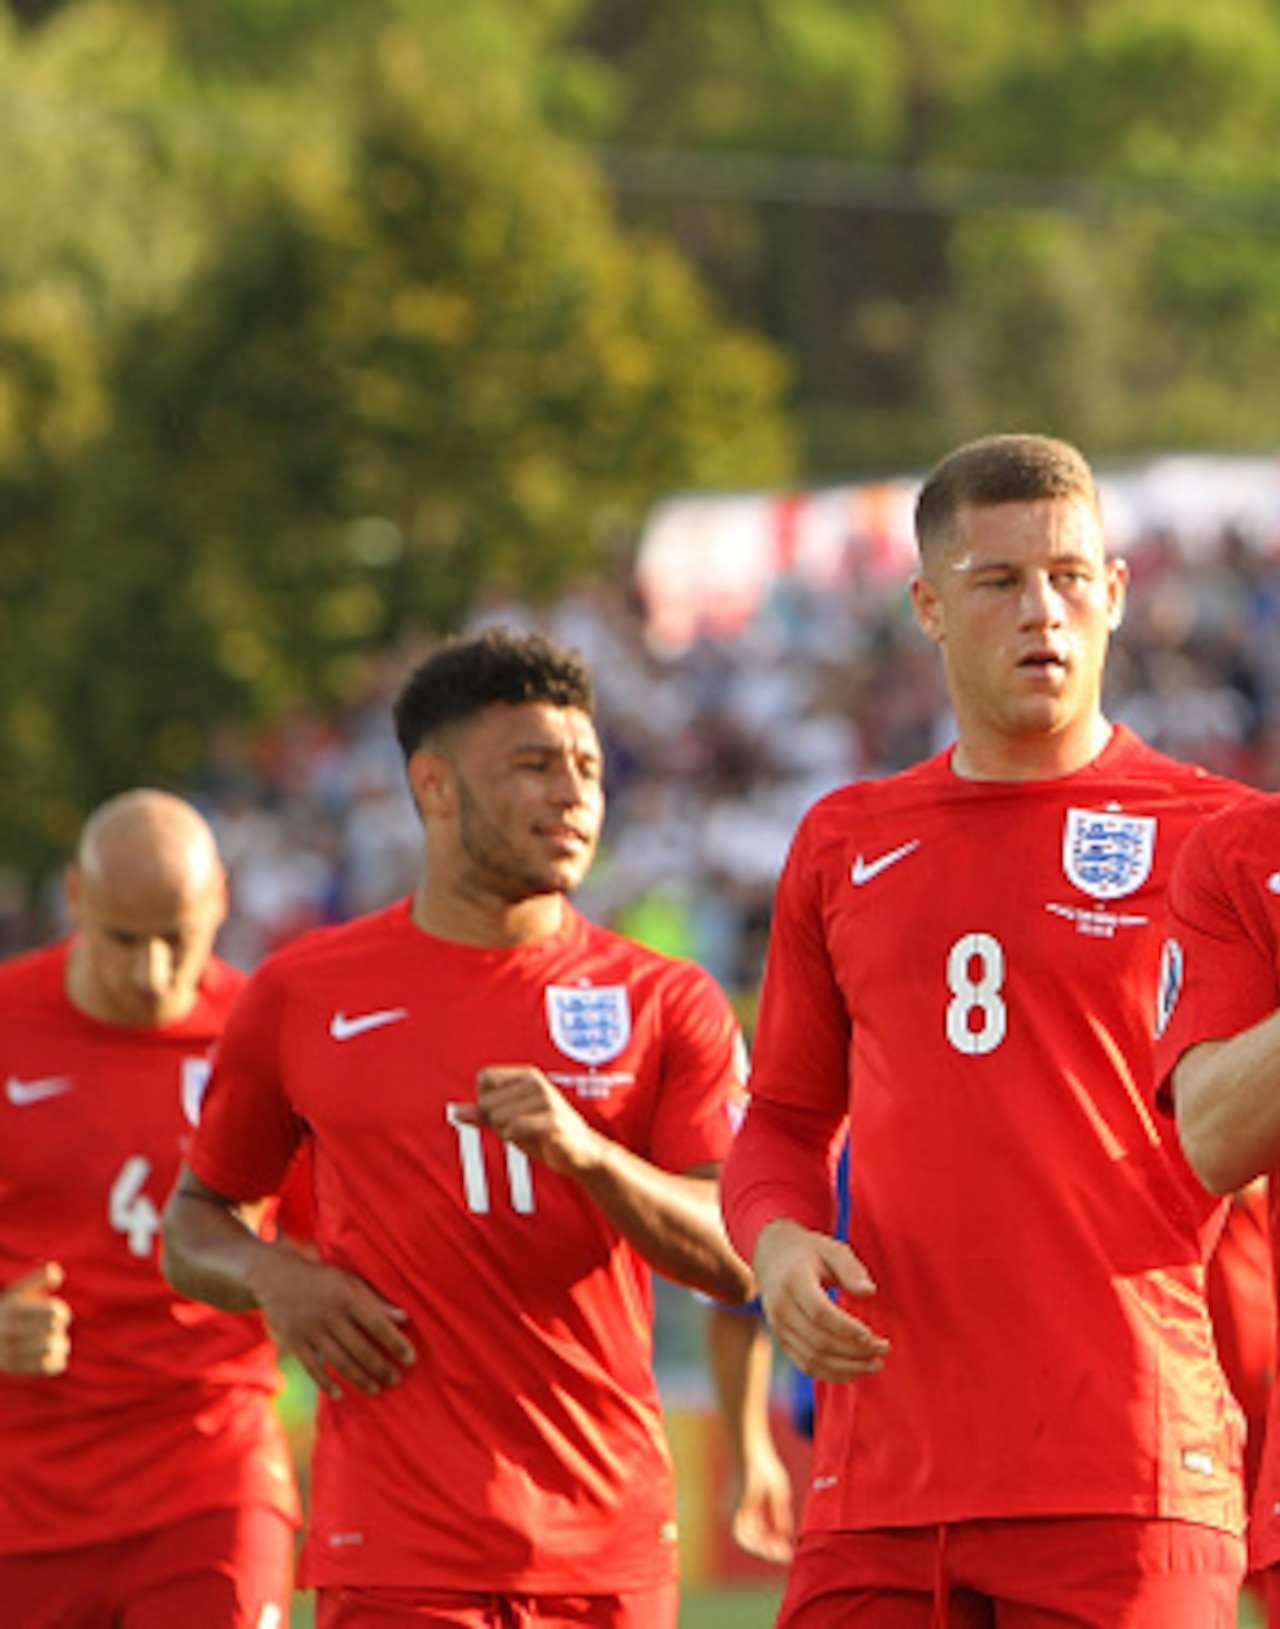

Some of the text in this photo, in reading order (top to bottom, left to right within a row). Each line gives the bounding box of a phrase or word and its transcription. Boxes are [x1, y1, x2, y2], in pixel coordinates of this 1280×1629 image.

[946, 931, 1007, 1056] 8
[109, 1155, 164, 1257] 4
[446, 1102, 536, 1215] 11
